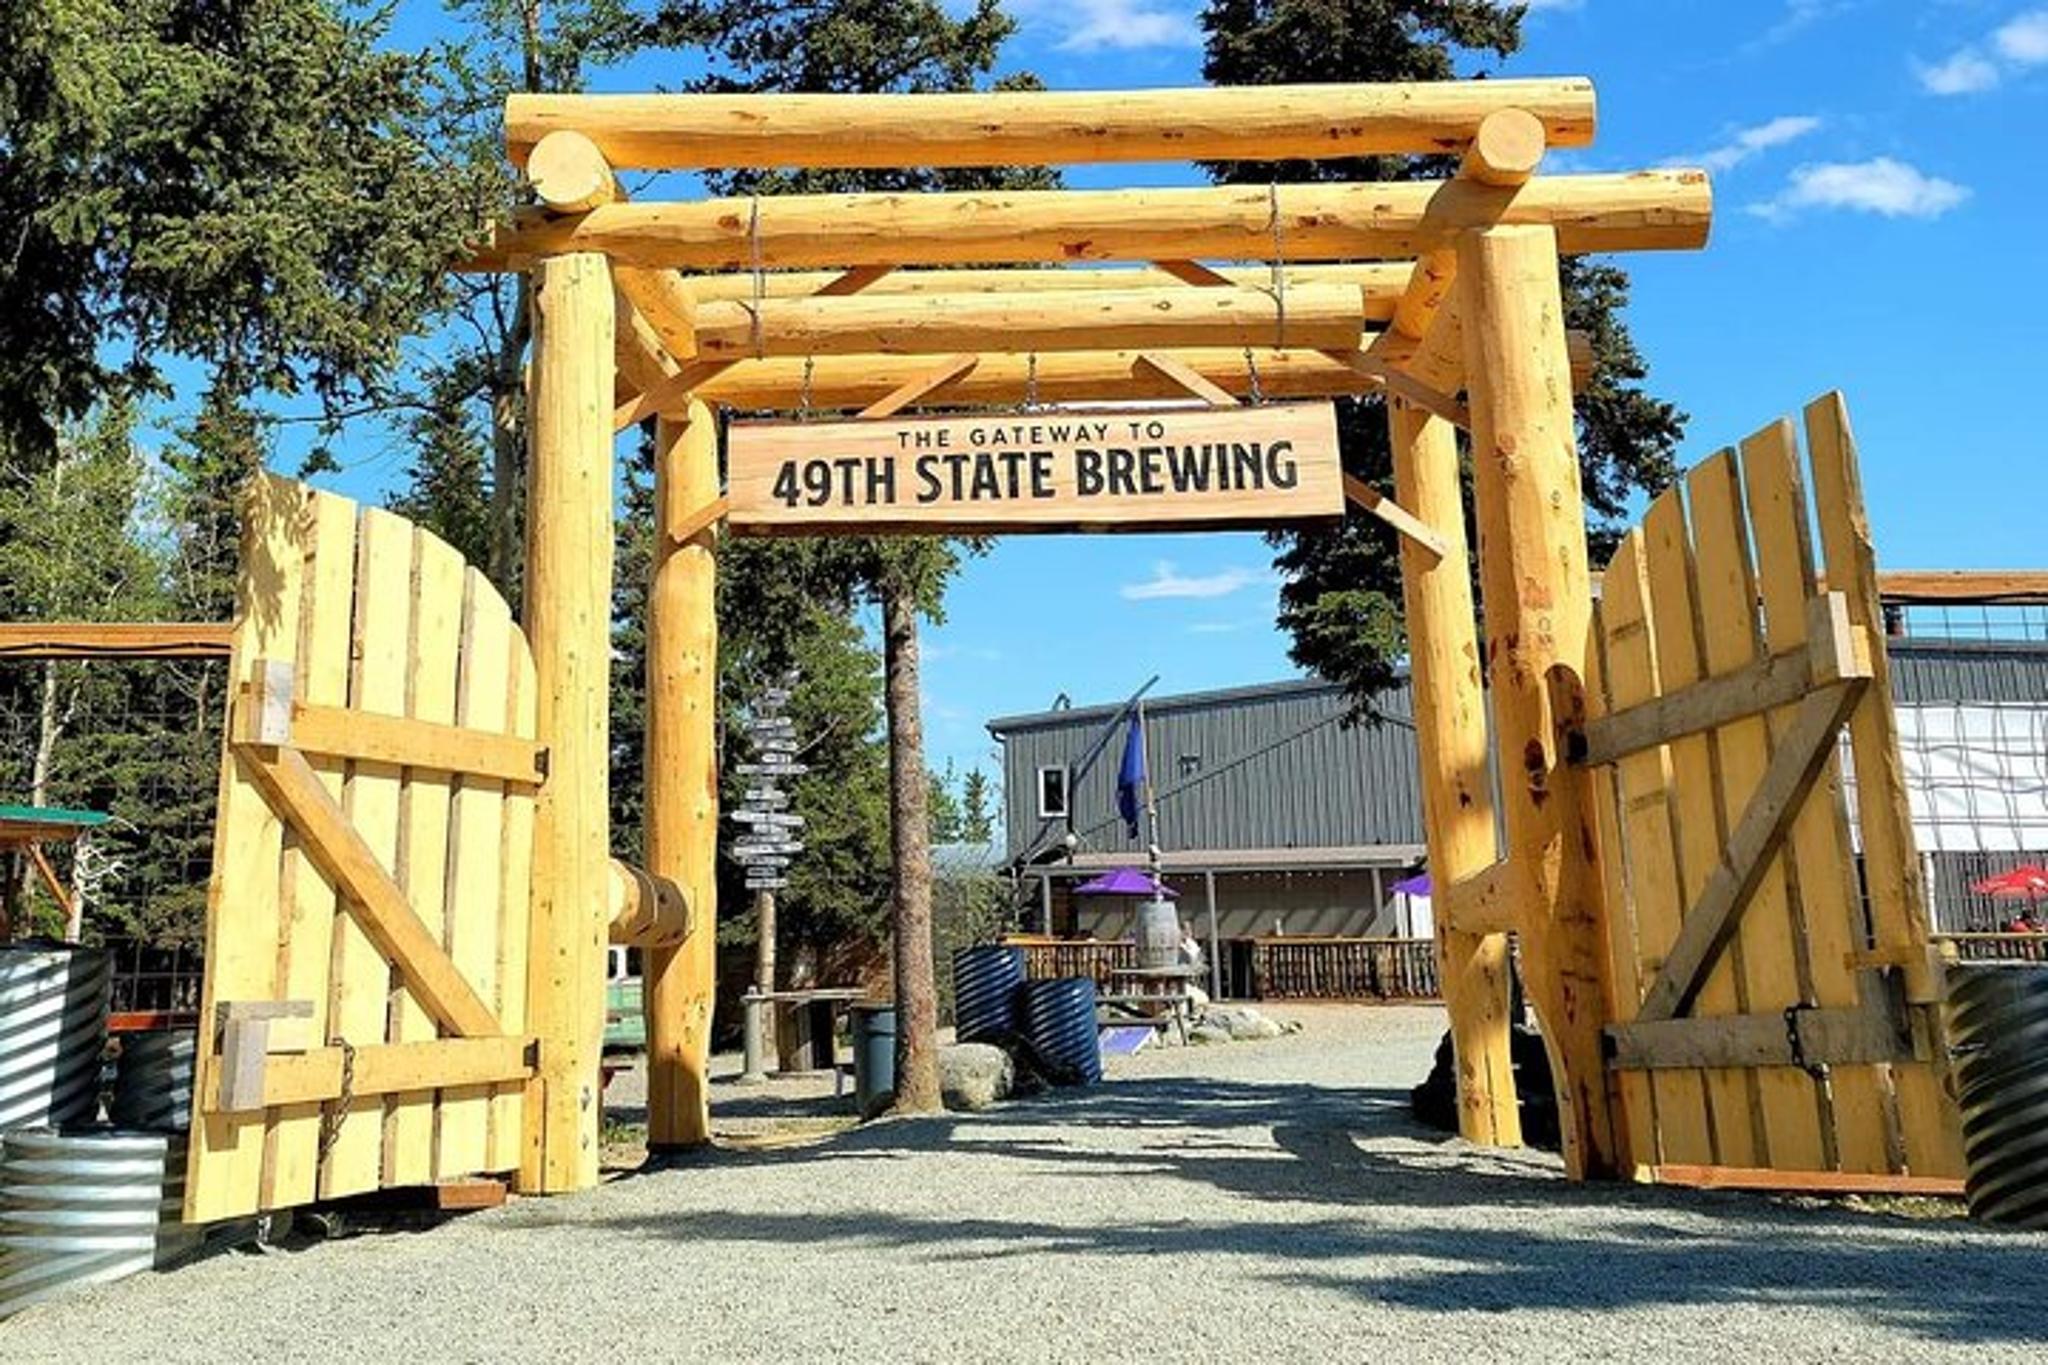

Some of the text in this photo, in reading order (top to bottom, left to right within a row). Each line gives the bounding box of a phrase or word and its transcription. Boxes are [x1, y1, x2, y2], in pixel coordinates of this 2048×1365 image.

[897, 421, 1164, 449] THE GATEWAY TO
[772, 441, 1298, 508] 49TH STATE BREWING
